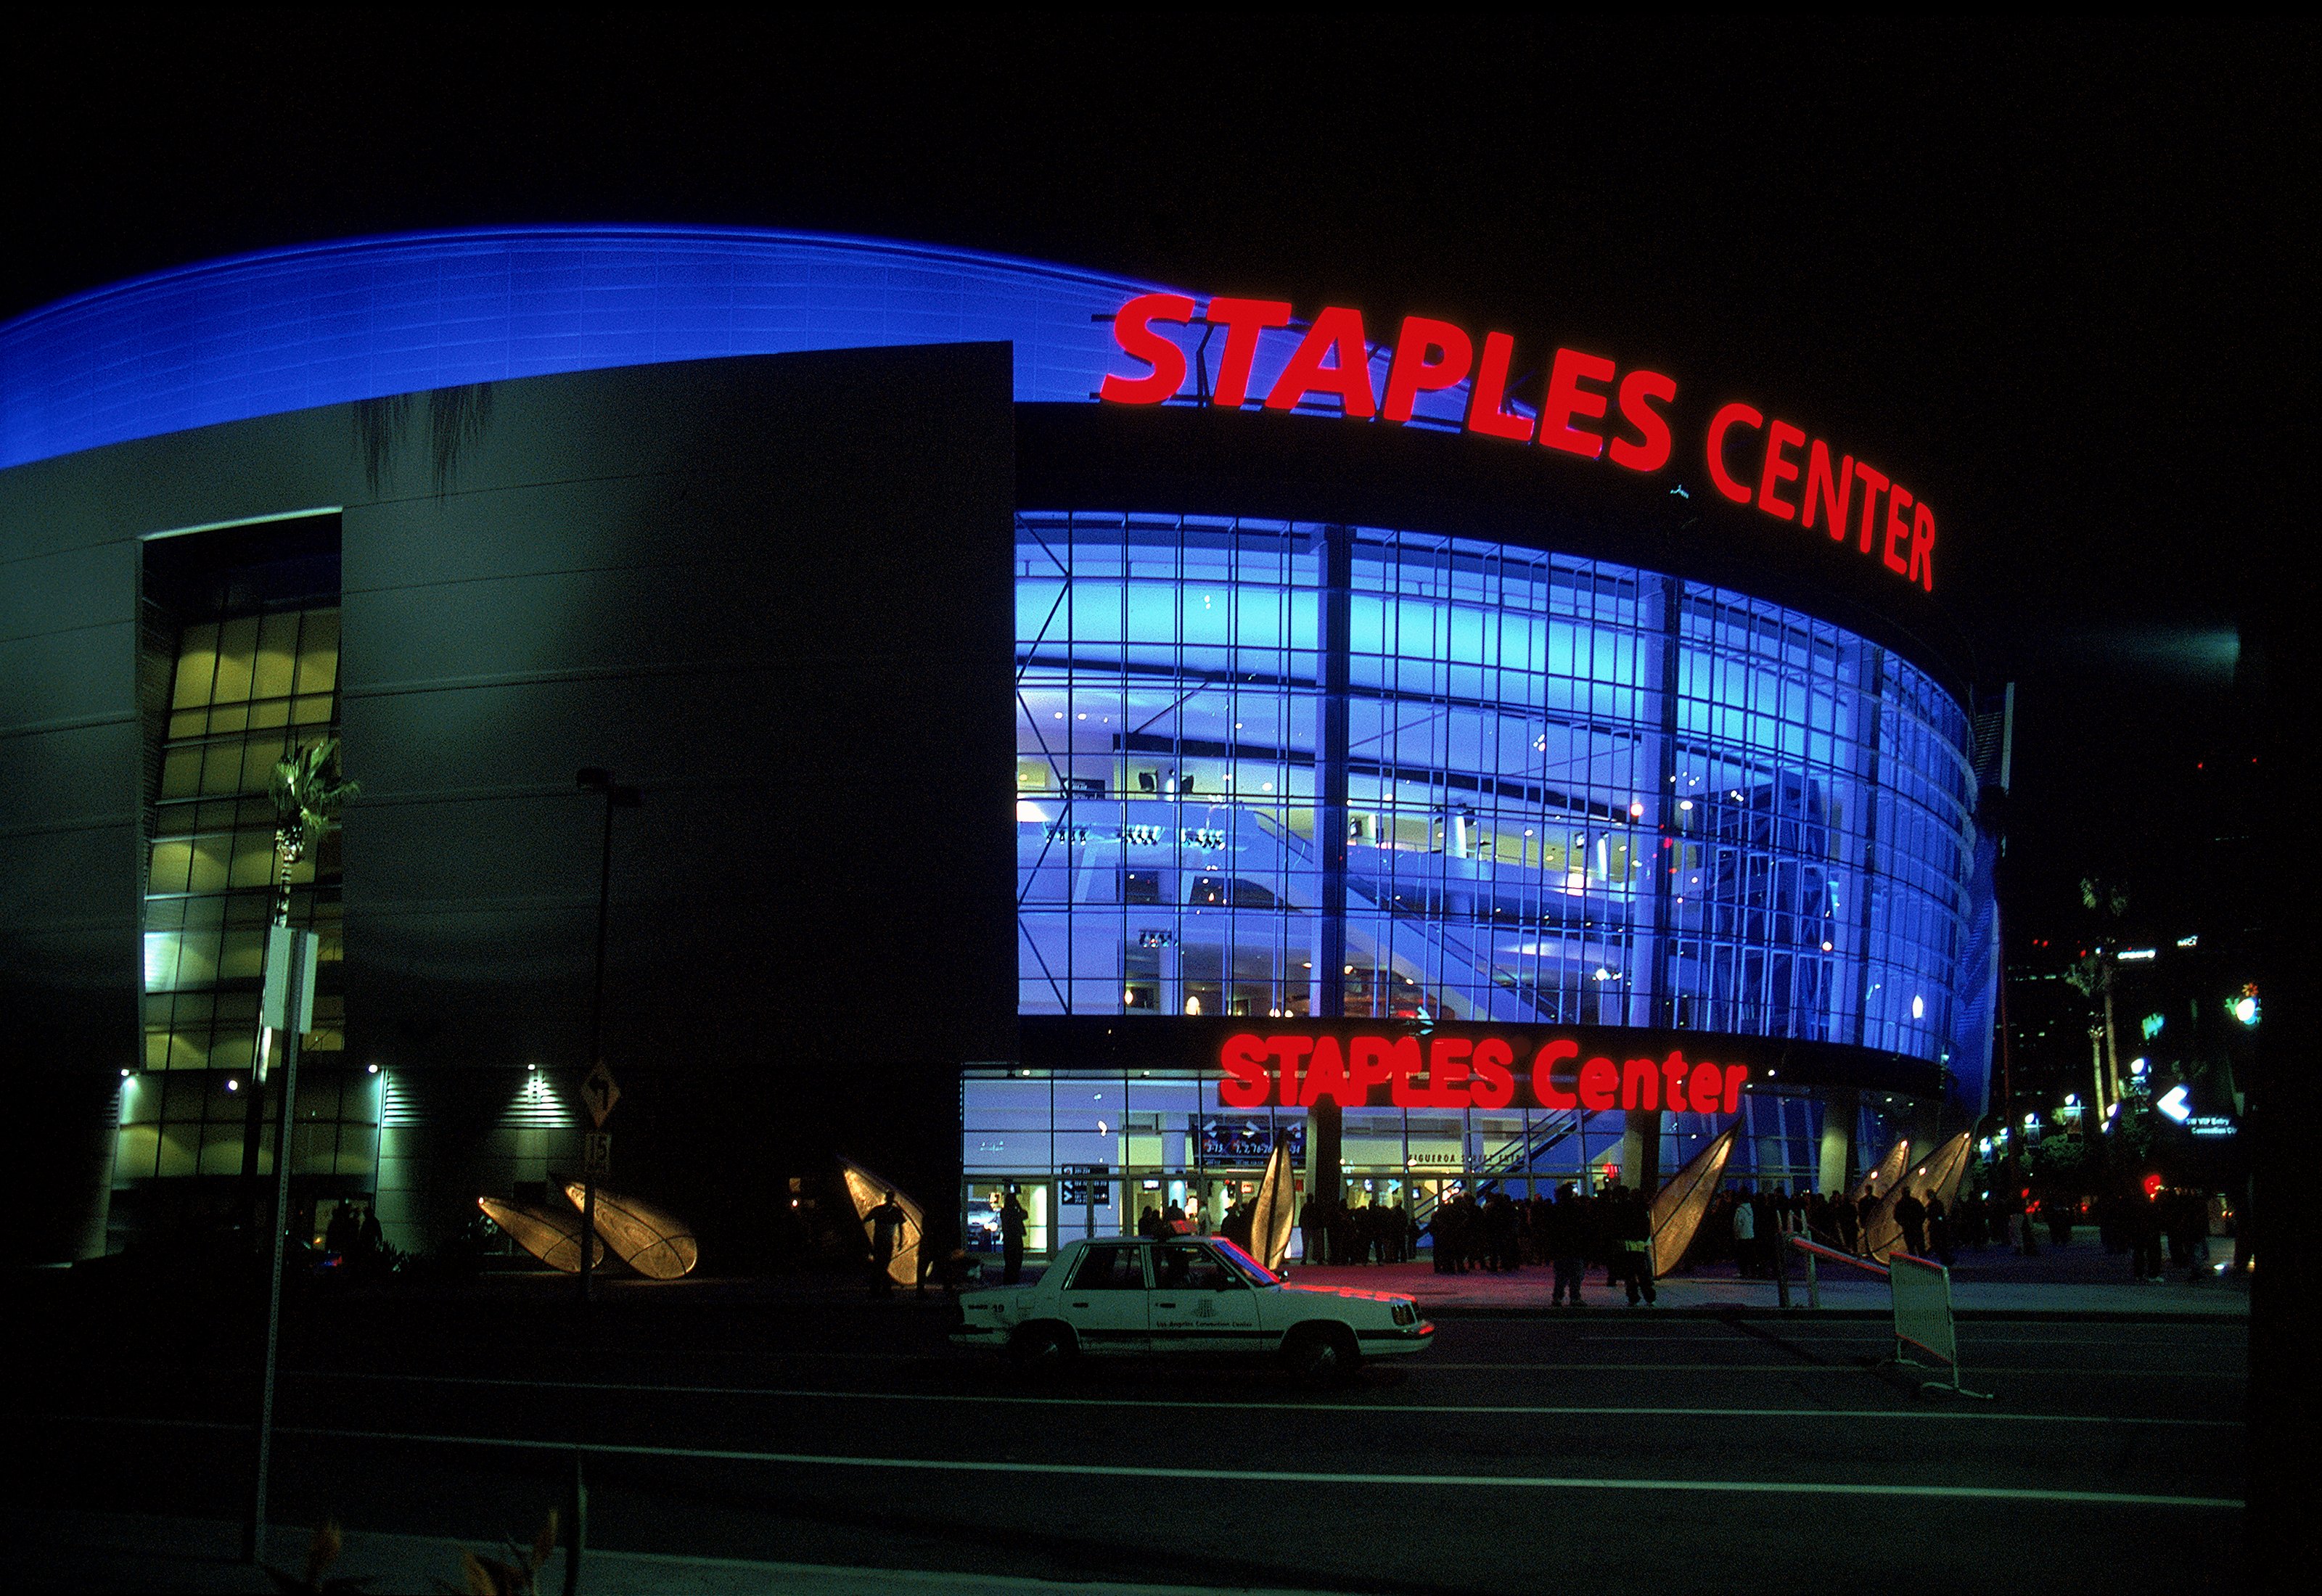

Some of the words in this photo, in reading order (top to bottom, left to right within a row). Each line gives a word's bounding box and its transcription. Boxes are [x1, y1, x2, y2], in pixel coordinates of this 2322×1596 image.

[1099, 292, 1677, 472] STAPLES
[1706, 402, 1936, 592] CENTER
[1220, 1033, 1514, 1110] STAPLES
[1532, 1038, 1748, 1114] Center
